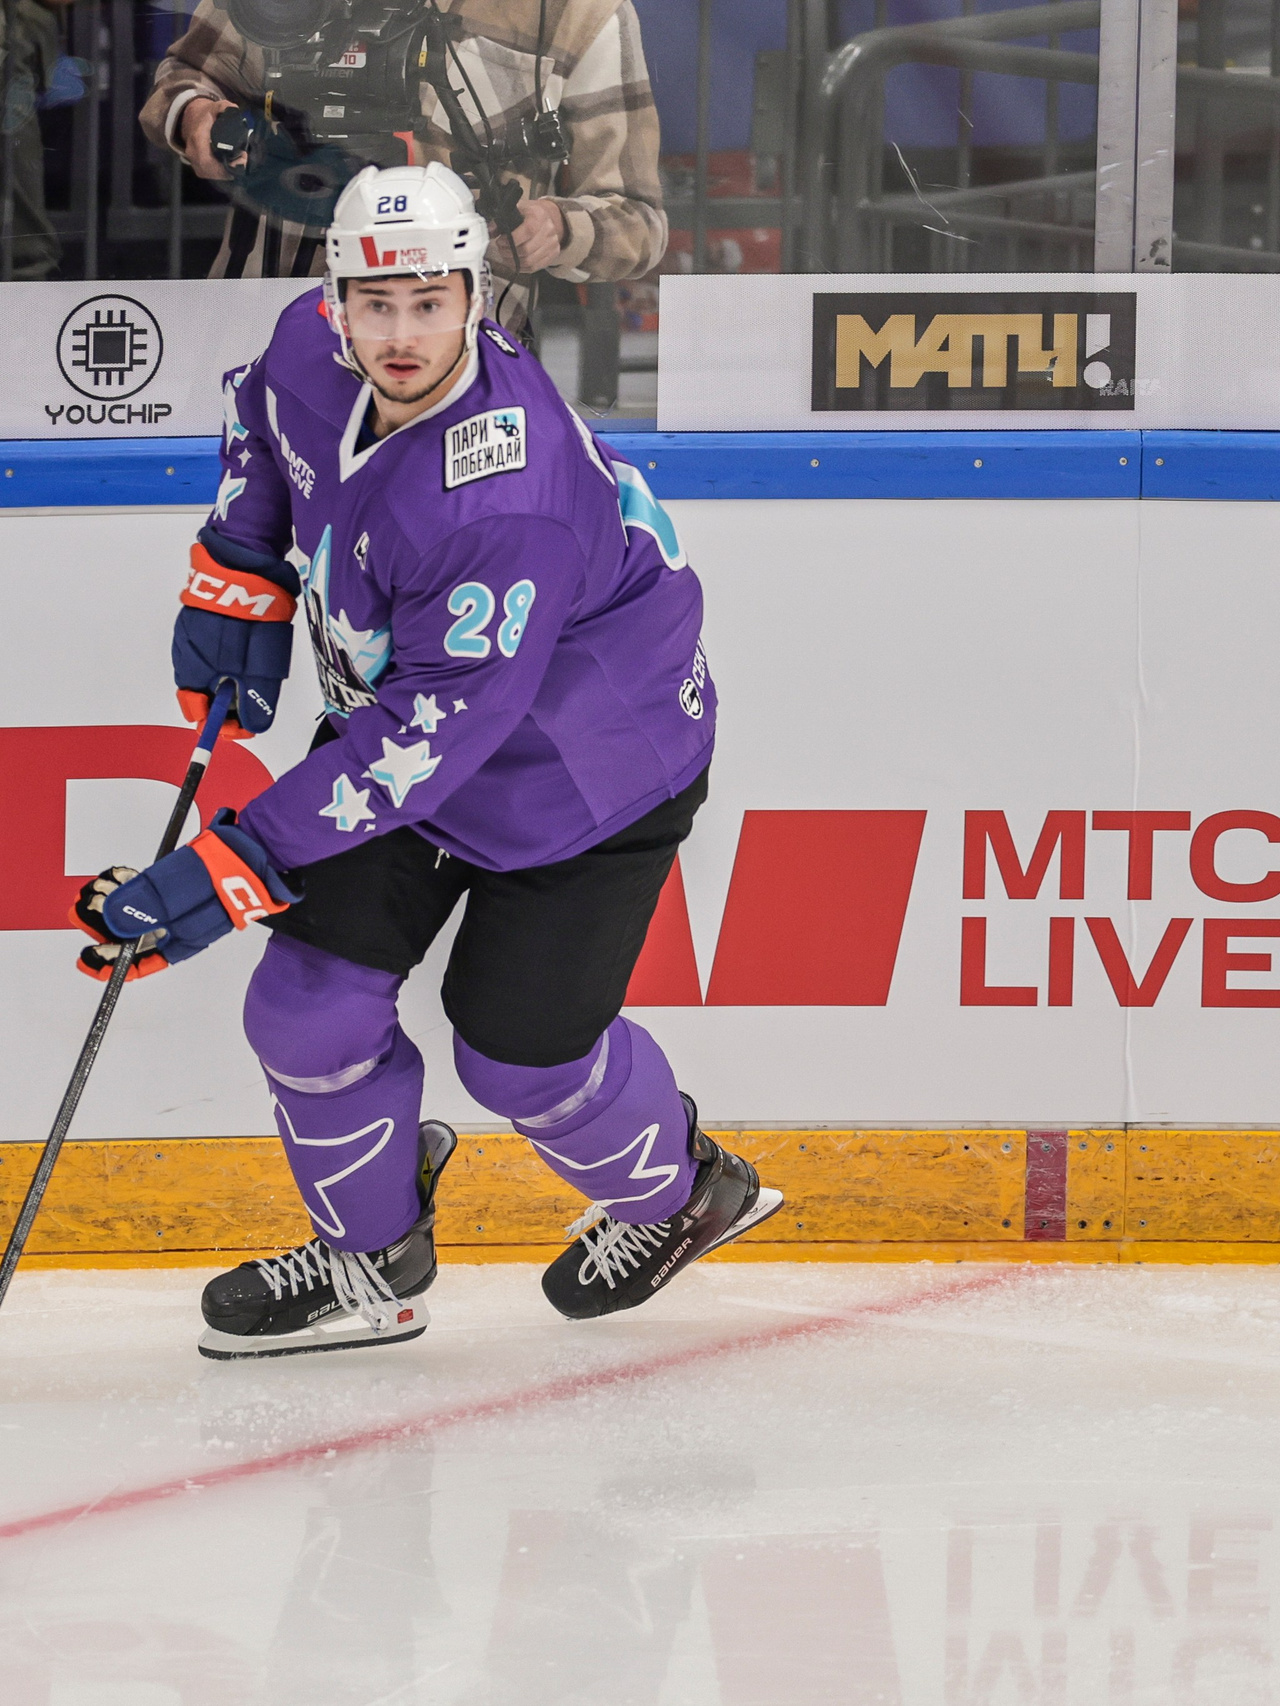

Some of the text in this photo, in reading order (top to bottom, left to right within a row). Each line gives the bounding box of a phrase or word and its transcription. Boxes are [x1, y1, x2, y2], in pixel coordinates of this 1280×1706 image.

[343, 54, 357, 65] 10
[377, 195, 408, 214] 28
[401, 255, 429, 266] LIVE
[45, 403, 172, 425] YOUCHIP
[452, 418, 489, 457] ПАРИ
[452, 437, 522, 481] ПОБЕЖДАЙ
[289, 464, 313, 500] LIVE
[443, 579, 536, 658] 28
[247, 689, 273, 716] CCM
[122, 905, 158, 925] CCM
[960, 917, 1280, 1008] LIVE
[307, 1300, 341, 1322] BAU
